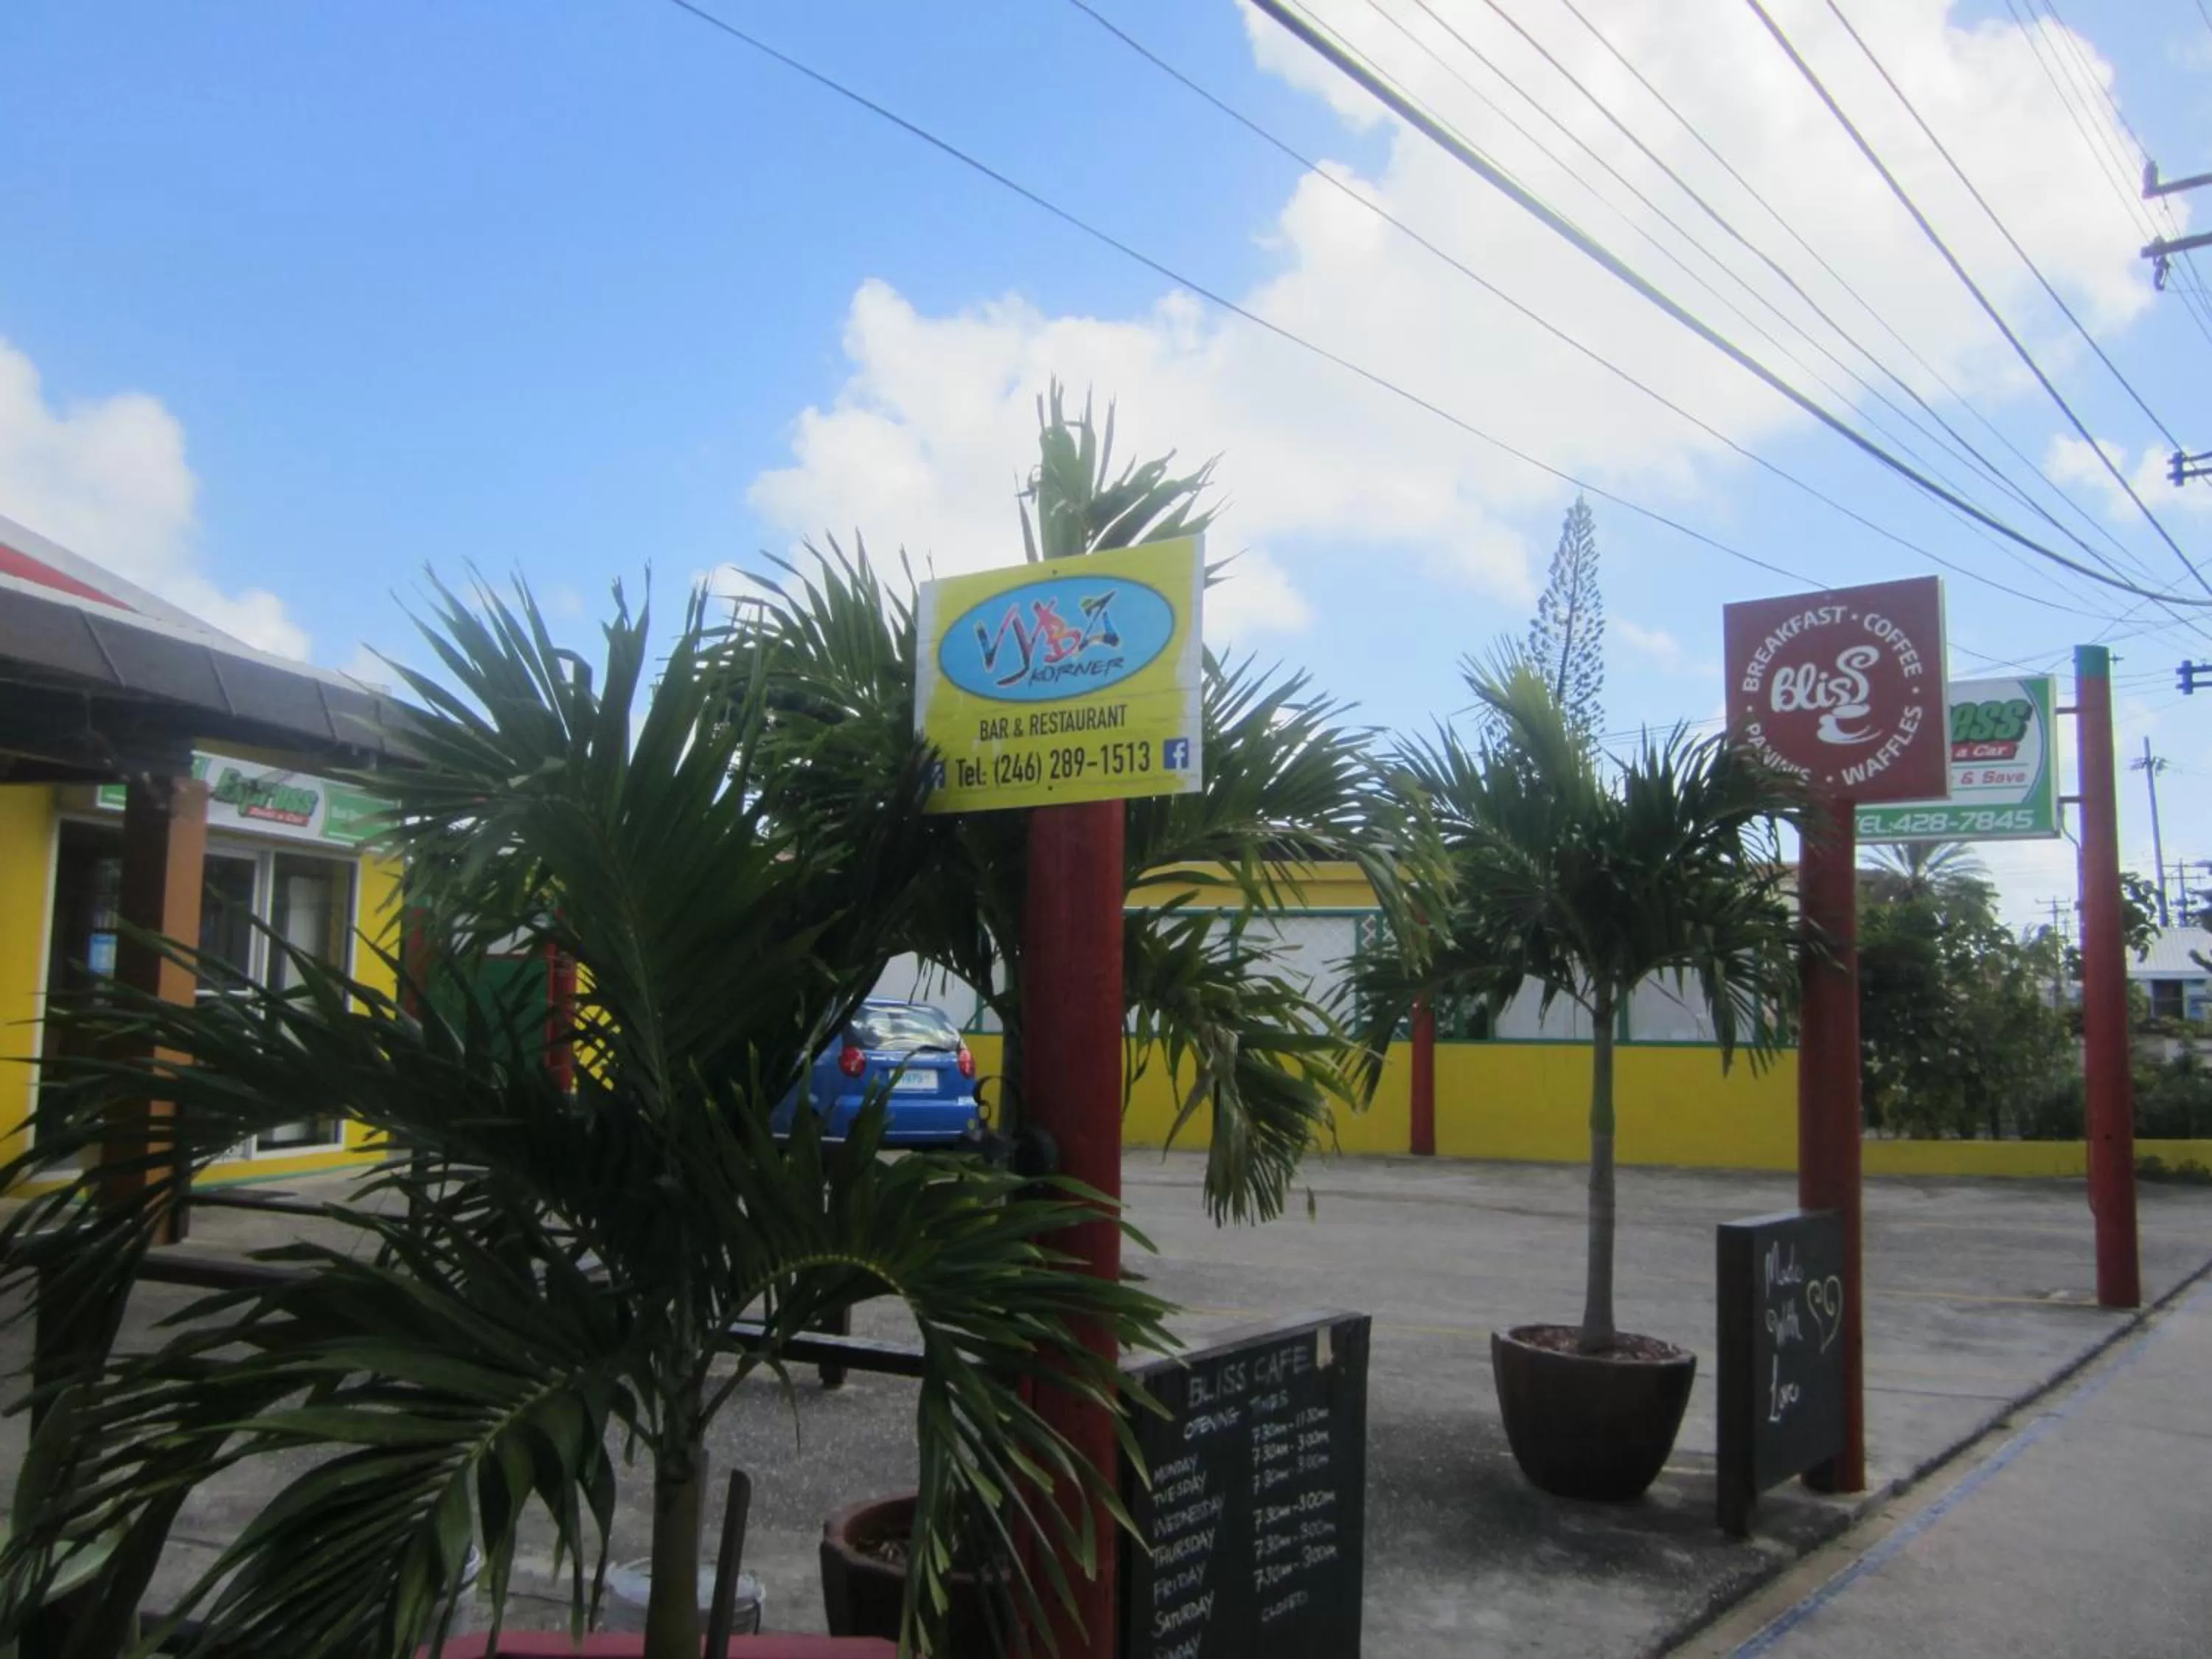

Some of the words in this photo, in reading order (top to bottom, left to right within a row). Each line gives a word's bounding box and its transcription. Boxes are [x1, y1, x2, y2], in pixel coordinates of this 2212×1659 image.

[1742, 606, 1847, 692] BREAKFAST
[1863, 613, 1923, 678] COFFEE
[979, 718, 1009, 742] BAR
[1014, 717, 1024, 737] &
[1031, 704, 1128, 737] RESTAURANT
[994, 751, 1042, 785] (246)
[1050, 741, 1150, 781] 289-1513
[1842, 706, 1923, 786] WAFFLES
[1973, 743, 2007, 757] Car
[1960, 771, 1975, 785] &
[1981, 770, 2025, 785] Save
[1856, 810, 2034, 835] EL:428-7845
[1188, 1361, 1247, 1408] BLISS
[1255, 1344, 1312, 1384] CAFE
